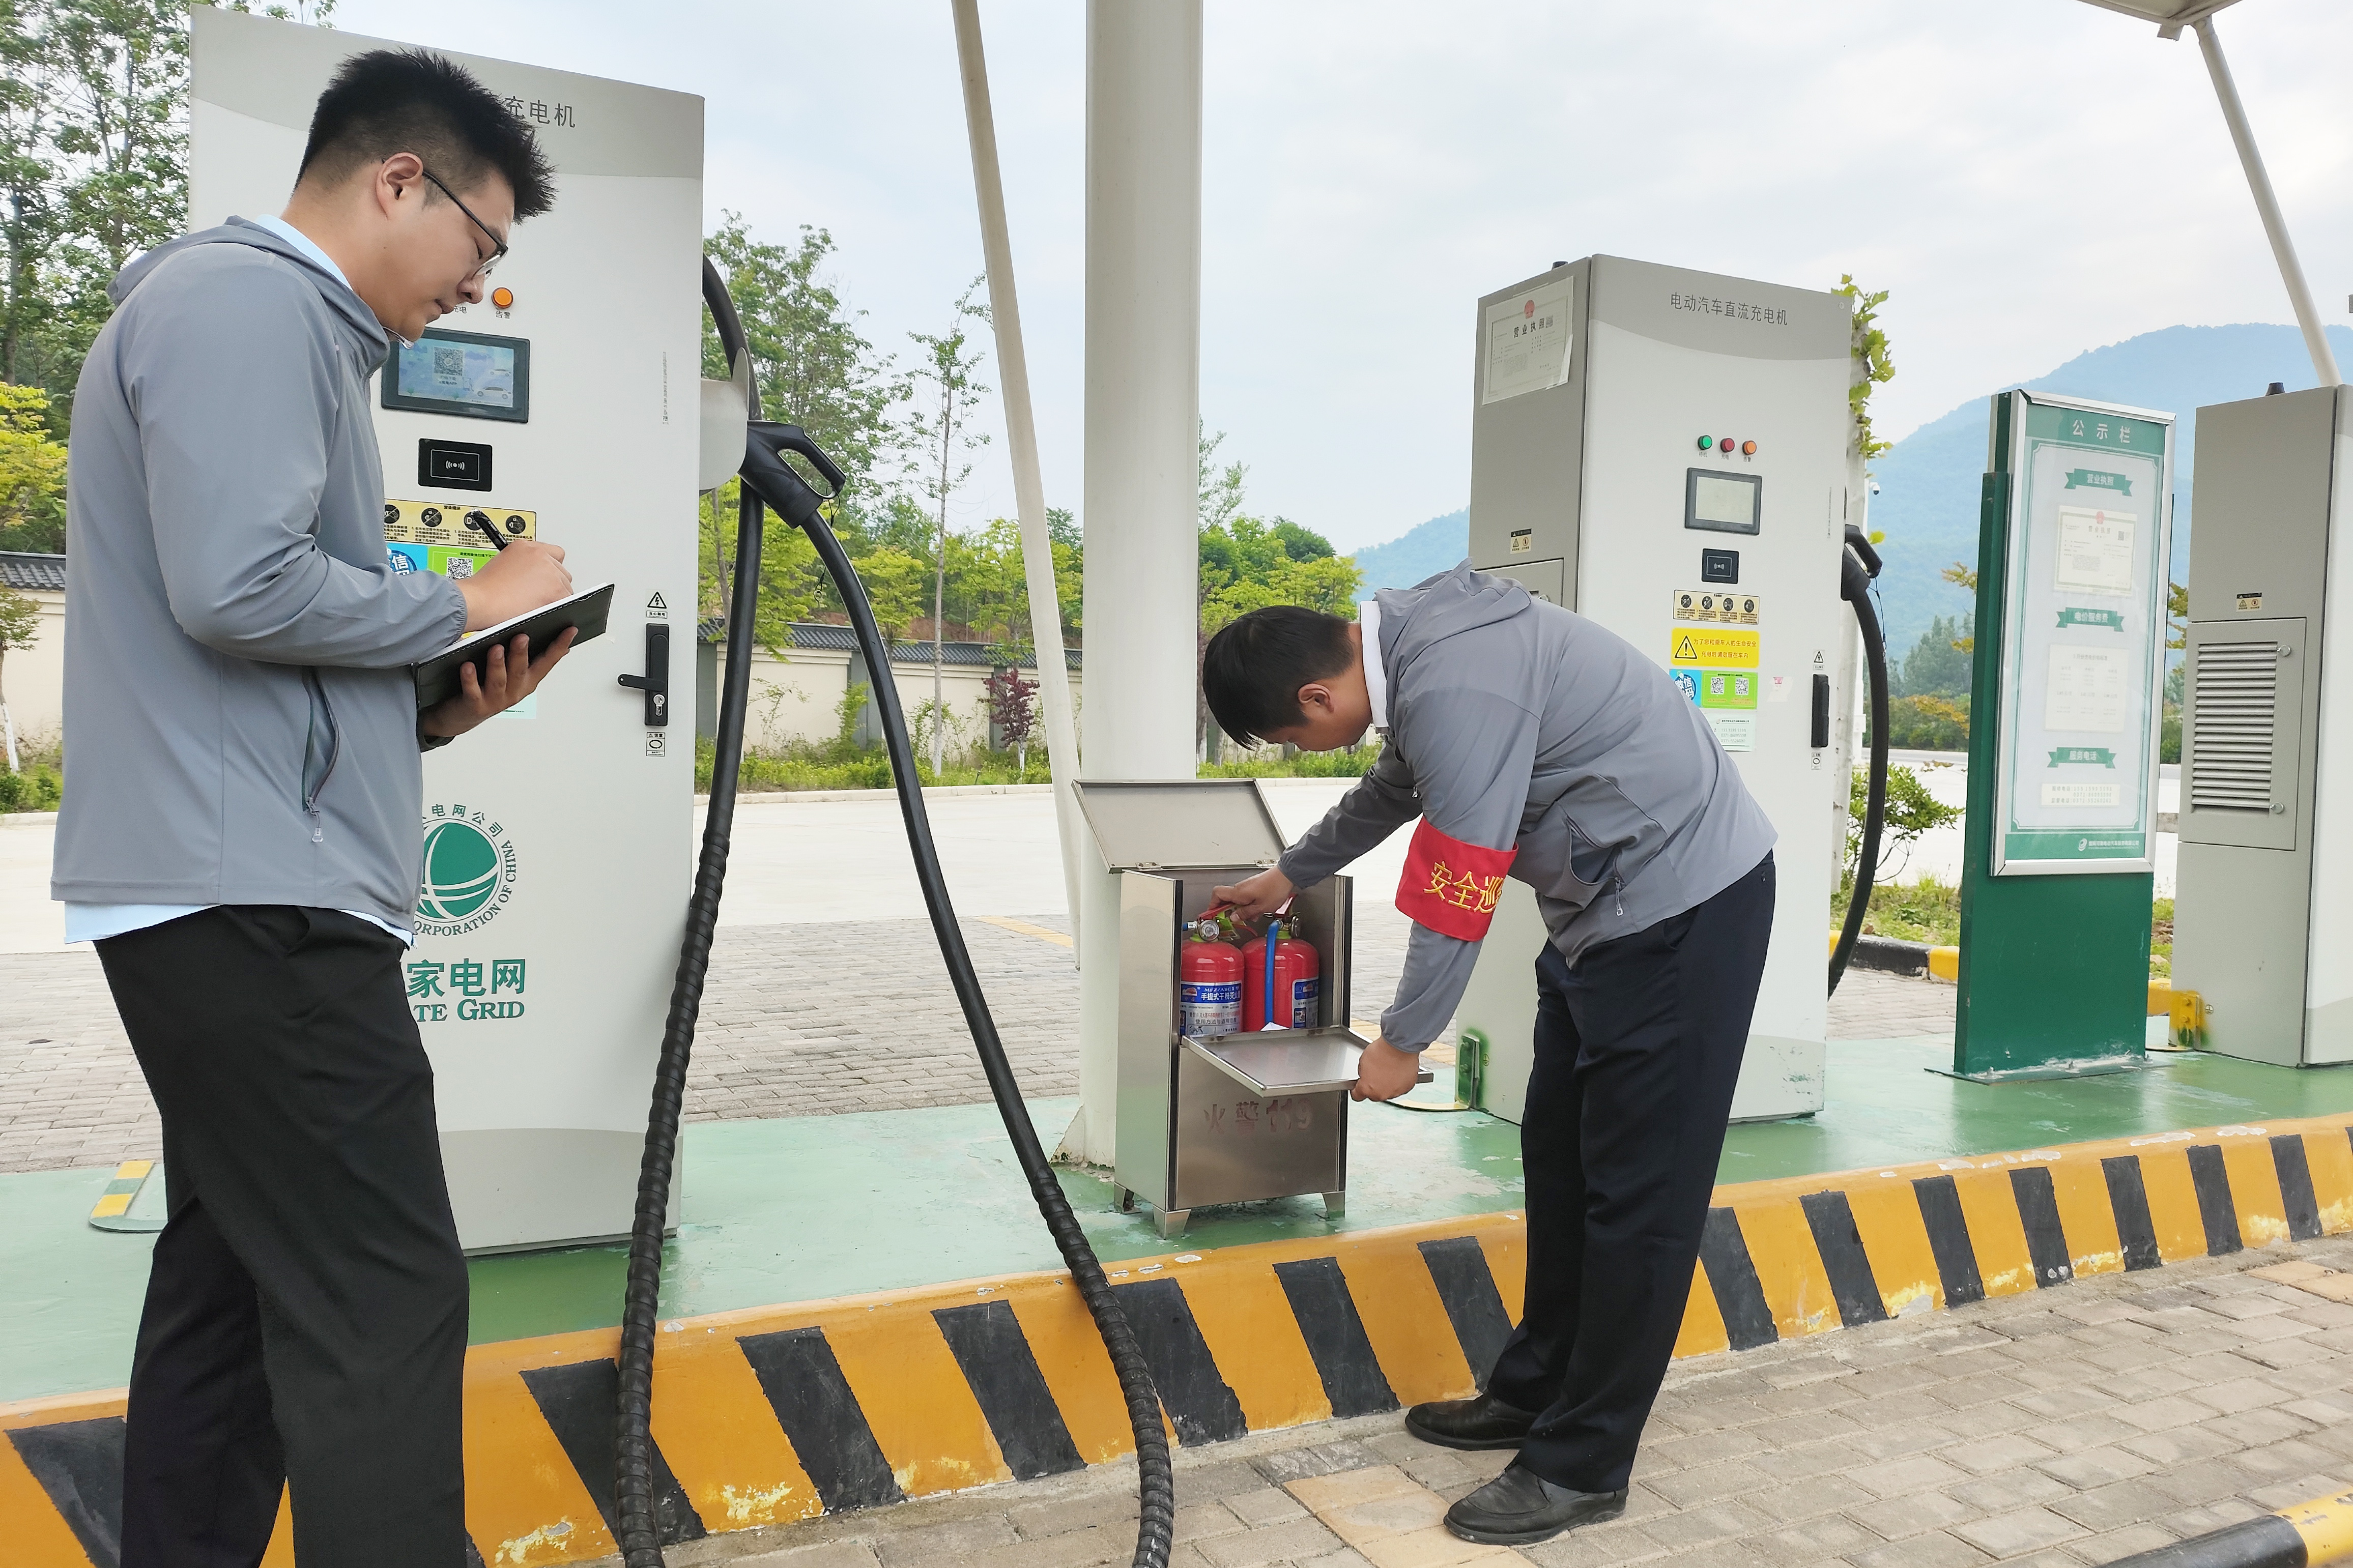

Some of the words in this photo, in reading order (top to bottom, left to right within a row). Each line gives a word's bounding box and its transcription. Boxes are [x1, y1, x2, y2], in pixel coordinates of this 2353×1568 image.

[496, 310, 511, 320] 告警
[1671, 292, 1788, 326] 电动汽车直流充电机
[1513, 317, 1545, 338] 营业执照
[2073, 419, 2131, 444] 公示栏
[2087, 474, 2114, 486] 营业执照
[1694, 638, 1757, 647] 为了您和乘车人的生命安全
[1682, 688, 1694, 698] 码
[2069, 750, 2097, 761] 服务电话
[422, 803, 504, 837] 电网公司
[501, 839, 516, 882] CHINA
[498, 884, 512, 903] OF
[1423, 860, 1504, 914] 安全巡
[457, 999, 525, 1021] GRID
